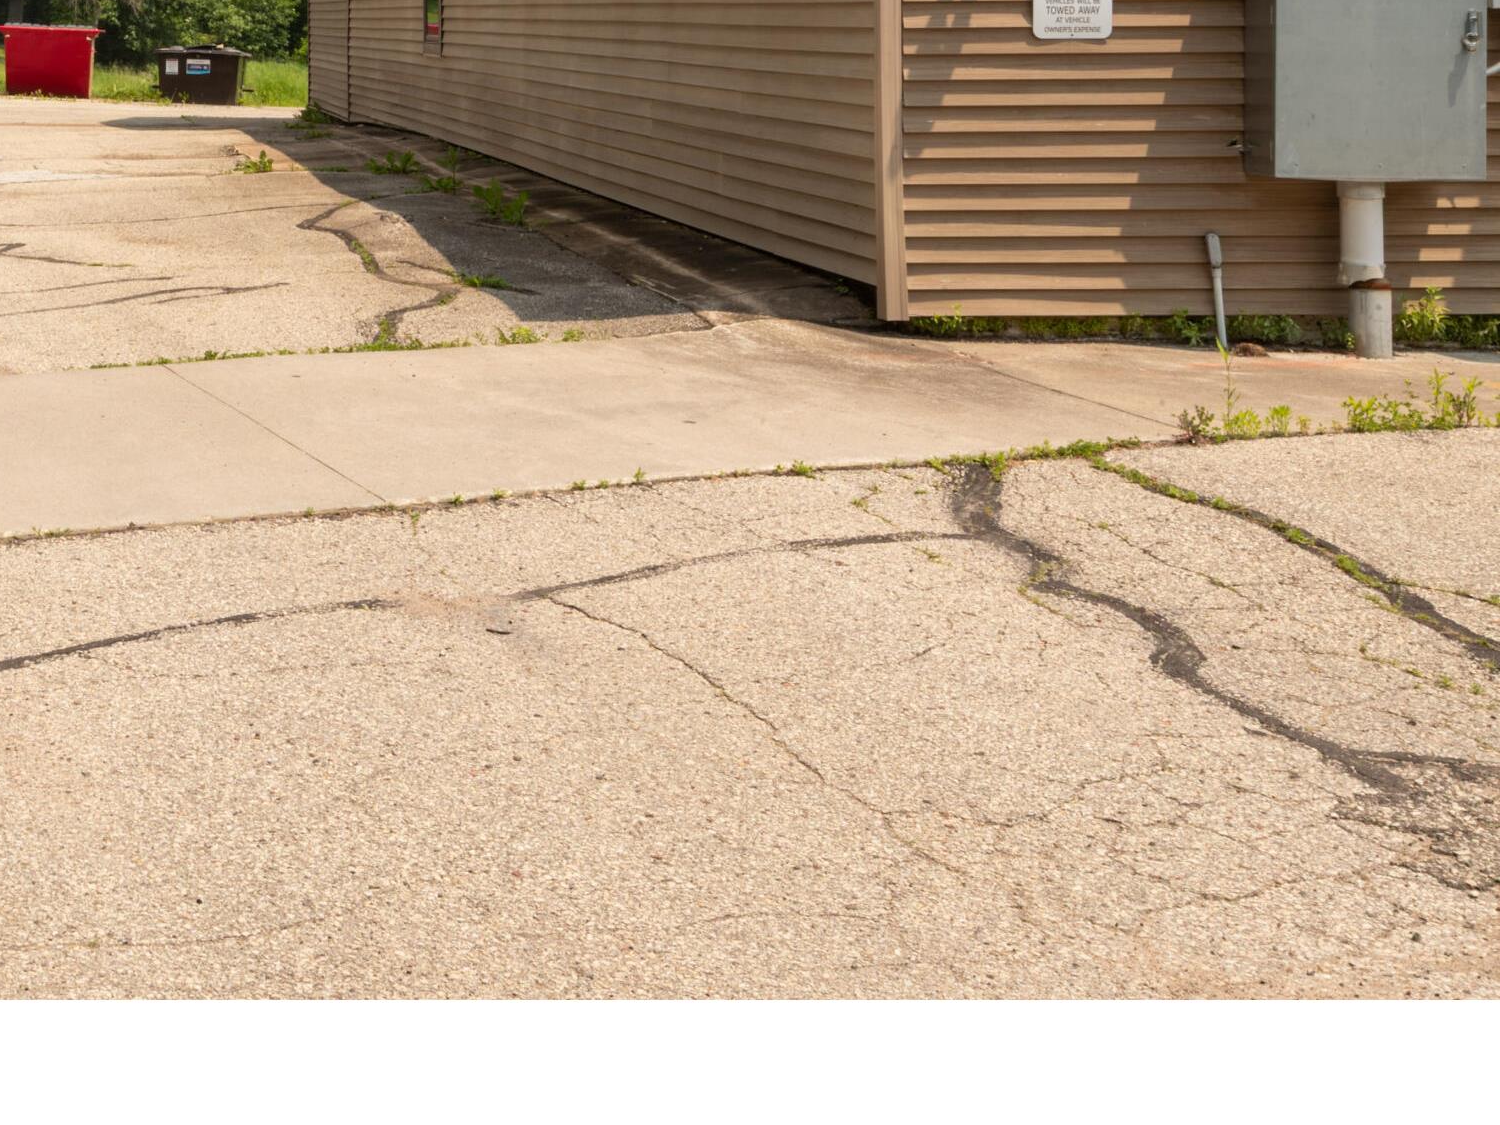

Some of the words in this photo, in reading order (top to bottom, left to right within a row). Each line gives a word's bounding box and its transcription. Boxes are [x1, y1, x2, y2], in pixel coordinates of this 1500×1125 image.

[1046, 6, 1075, 15] TOWED
[1078, 6, 1100, 15] AWAY
[1064, 16, 1091, 24] VEHICLE
